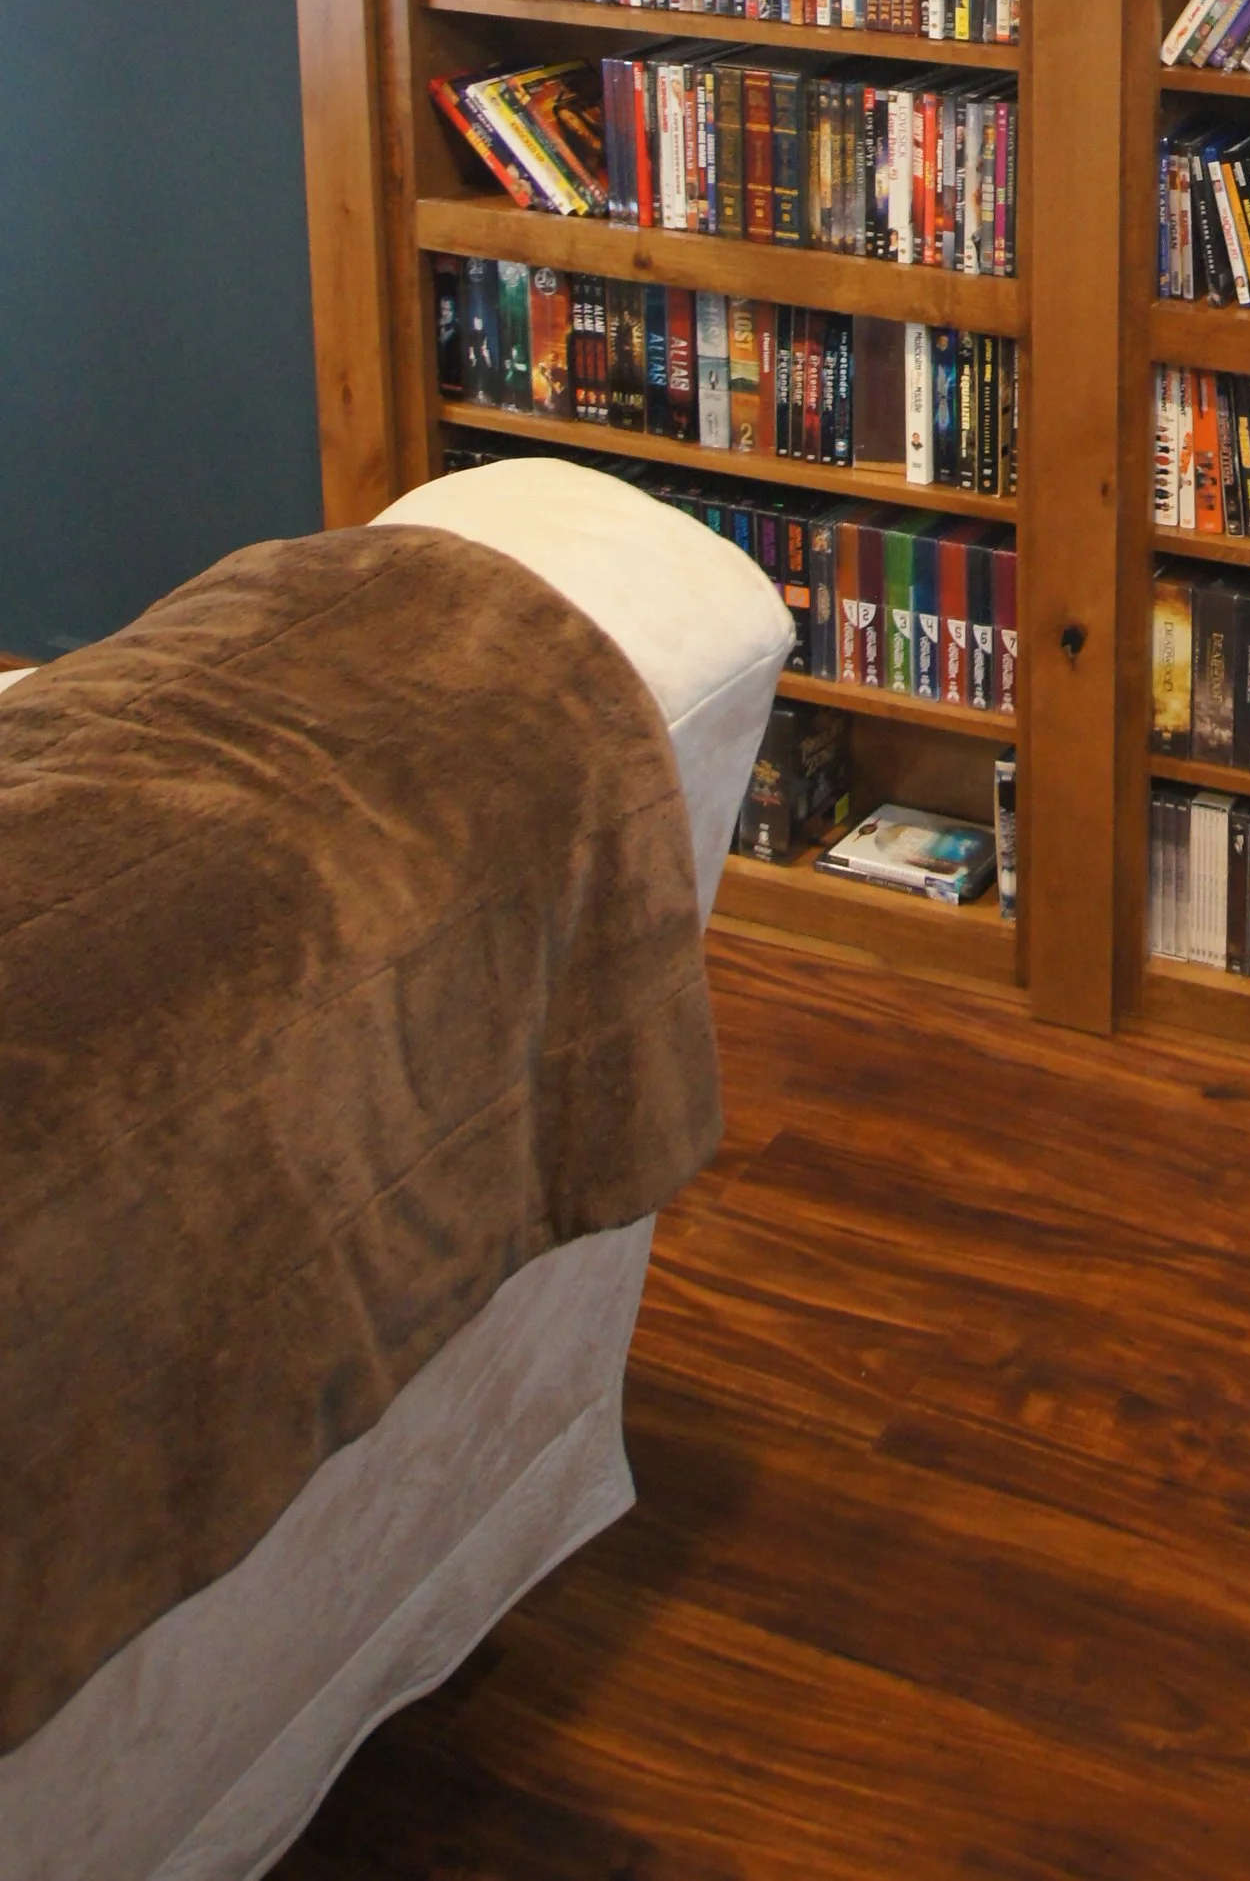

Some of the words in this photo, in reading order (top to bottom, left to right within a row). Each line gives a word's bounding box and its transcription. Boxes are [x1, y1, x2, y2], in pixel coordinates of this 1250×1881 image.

[648, 333, 666, 385] ALIAS
[733, 312, 753, 352] LOST
[670, 336, 690, 391] ALIAS
[779, 349, 789, 403] pretender
[794, 352, 804, 406] pretender
[809, 355, 818, 410] pretender
[825, 356, 835, 411] pretender
